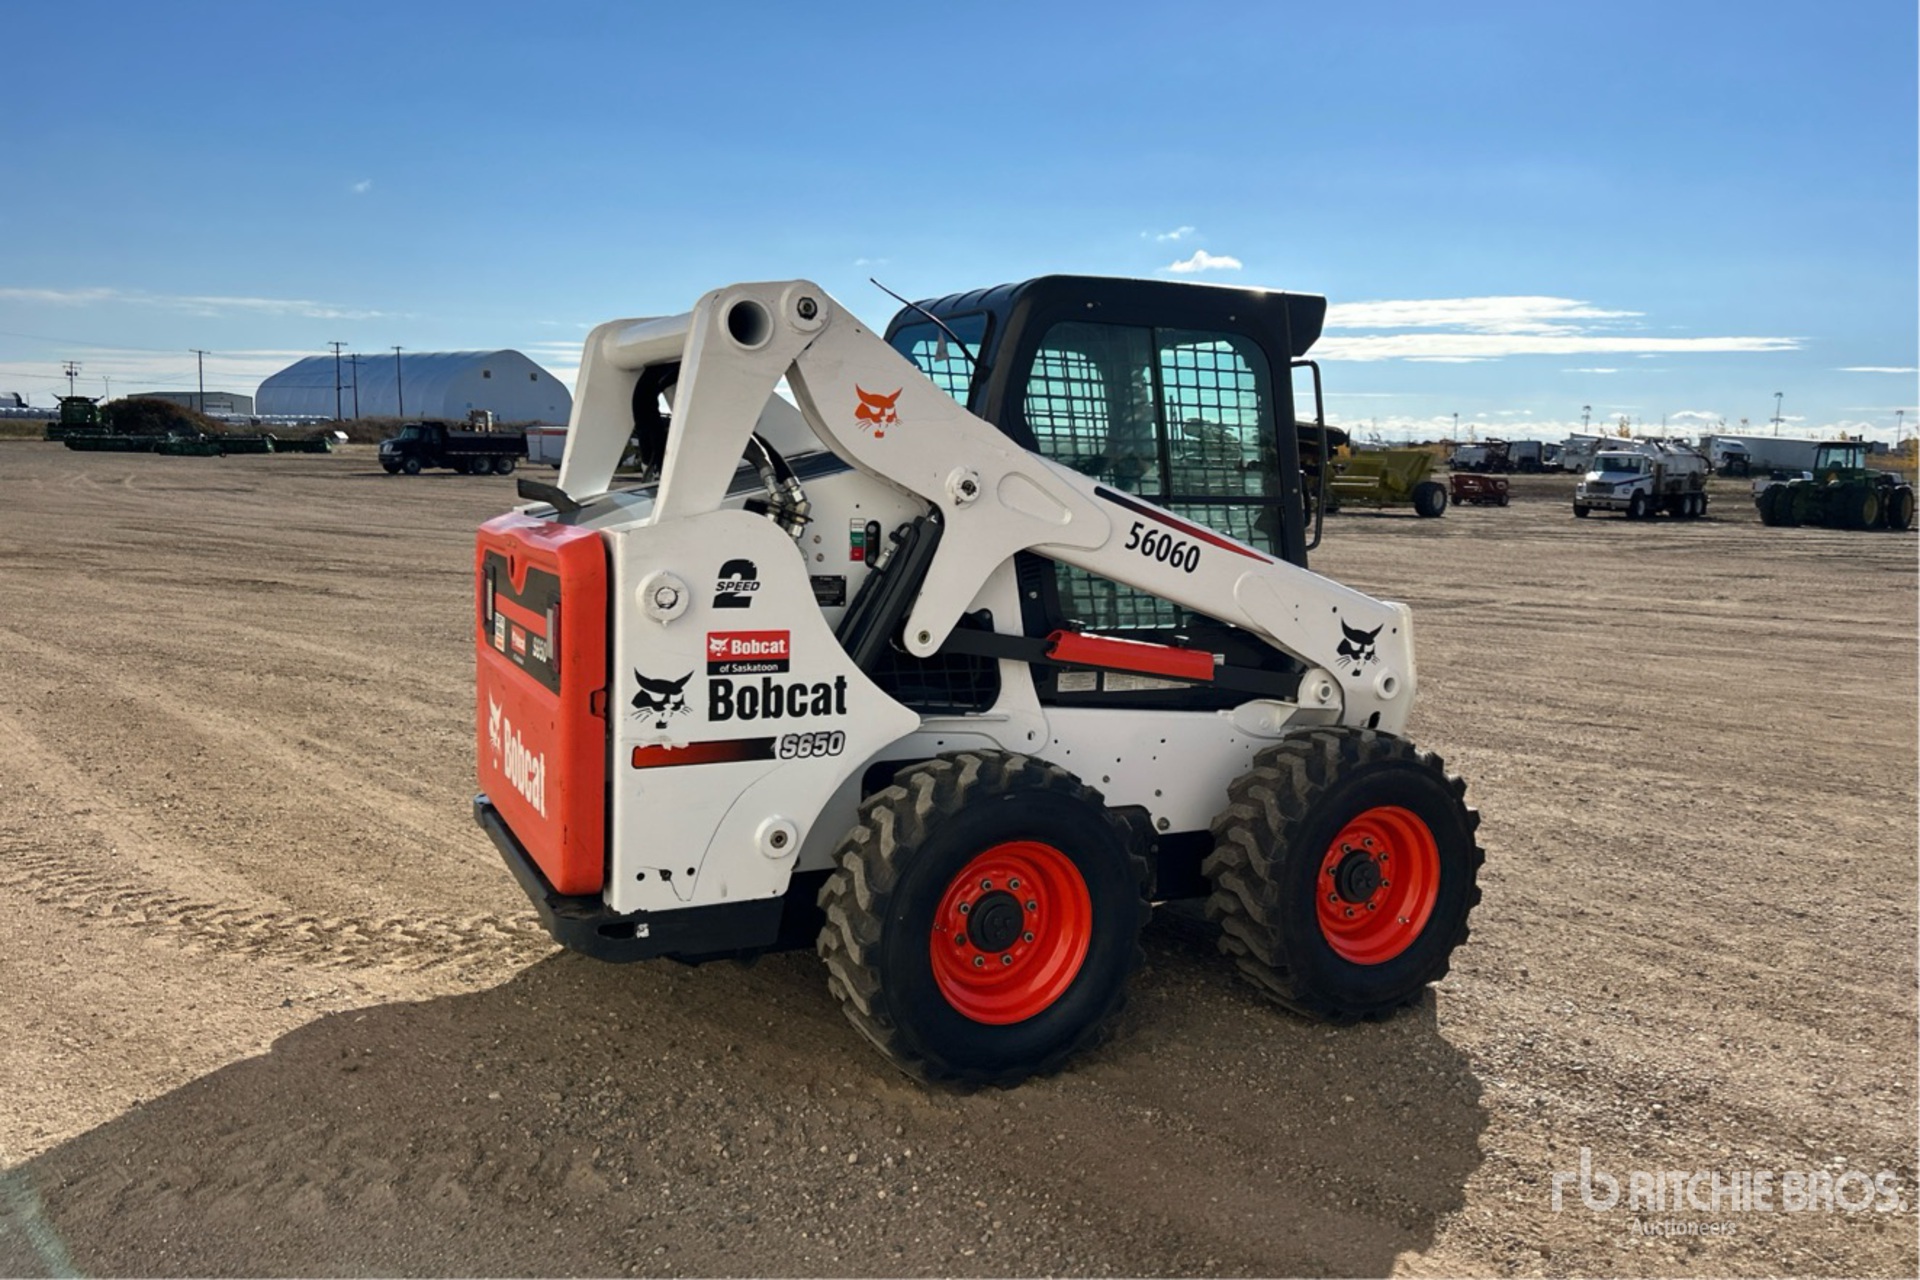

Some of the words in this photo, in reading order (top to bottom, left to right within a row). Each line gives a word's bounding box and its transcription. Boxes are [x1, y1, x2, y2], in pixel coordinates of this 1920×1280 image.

[1124, 521, 1201, 574] 56060
[712, 558, 758, 609] 2
[715, 581, 761, 592] SPEED
[731, 639, 786, 655] Bobcat
[719, 664, 730, 673] of
[731, 663, 779, 673] Saskatoon
[708, 675, 847, 722] Bobcat
[779, 730, 846, 760] S650
[504, 717, 545, 818] Bobcat
